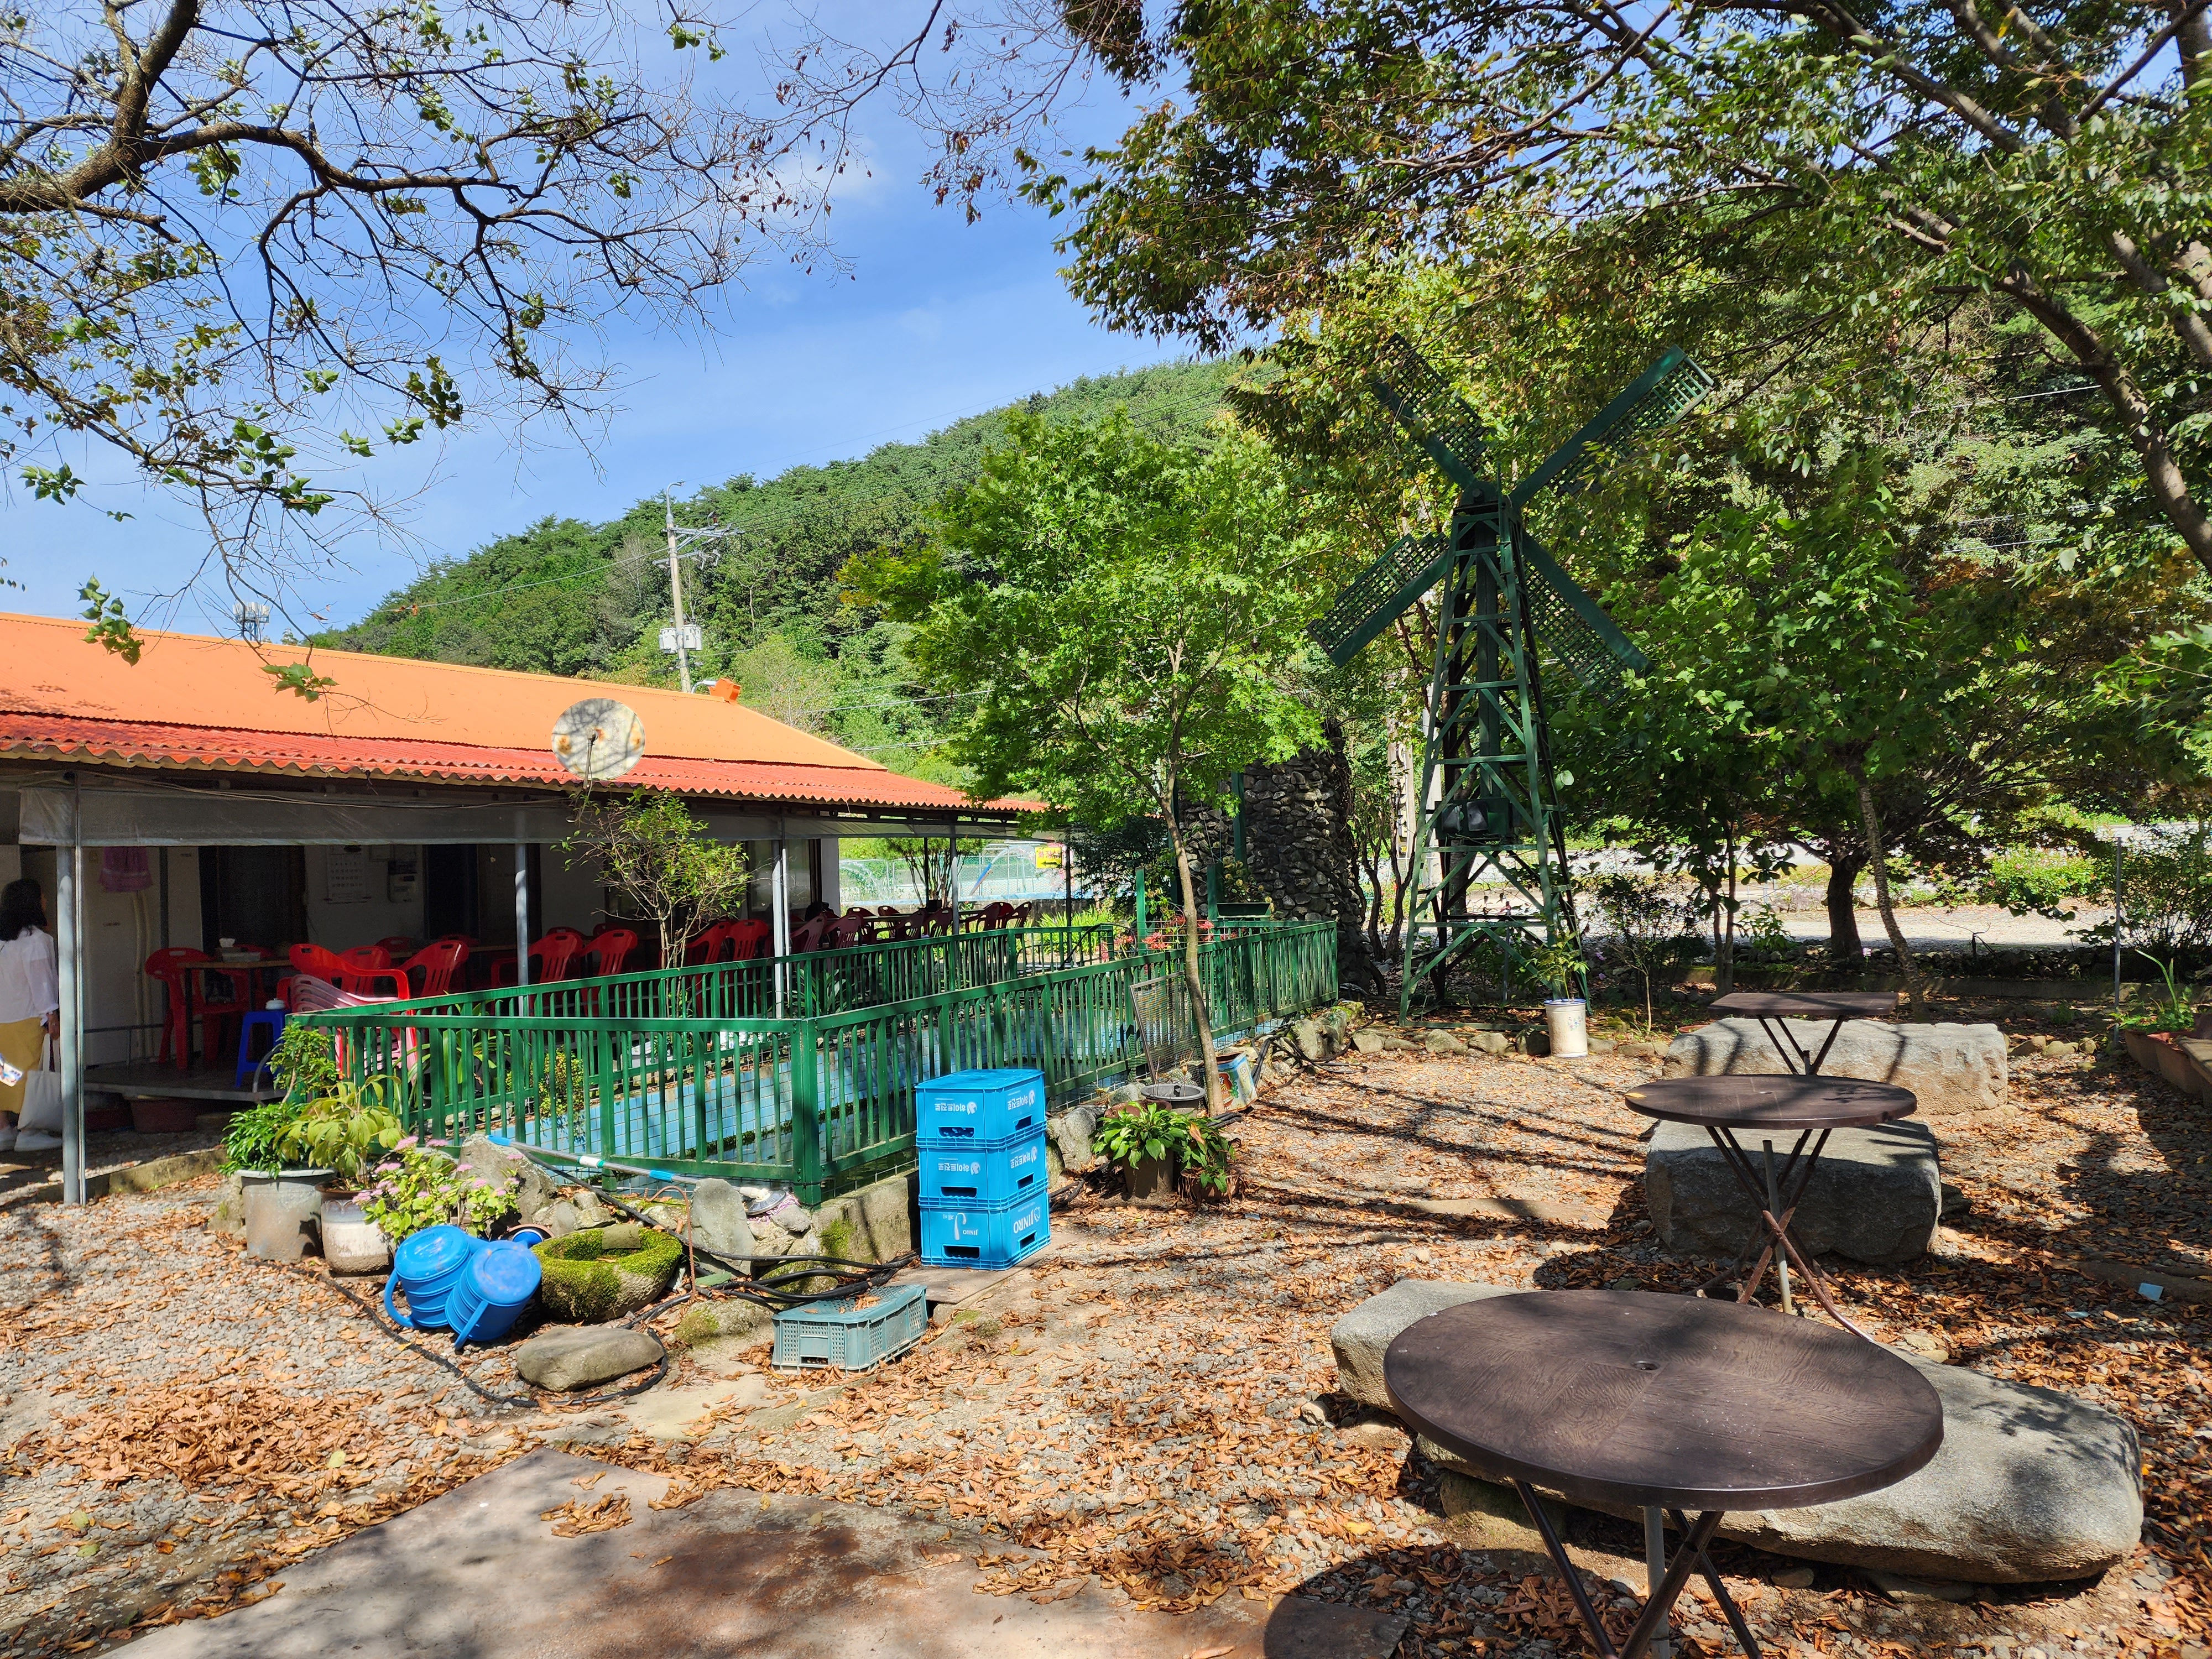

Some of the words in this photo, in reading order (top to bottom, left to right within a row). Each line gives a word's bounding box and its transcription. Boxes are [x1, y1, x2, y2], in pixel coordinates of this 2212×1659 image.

[935, 1103, 966, 1112] 하이트진로
[1007, 1095, 1029, 1110] 하이트진로
[938, 1162, 969, 1172] 하이트진로
[1010, 1151, 1031, 1168] 하이트진로
[1013, 1209, 1034, 1234] JINRO
